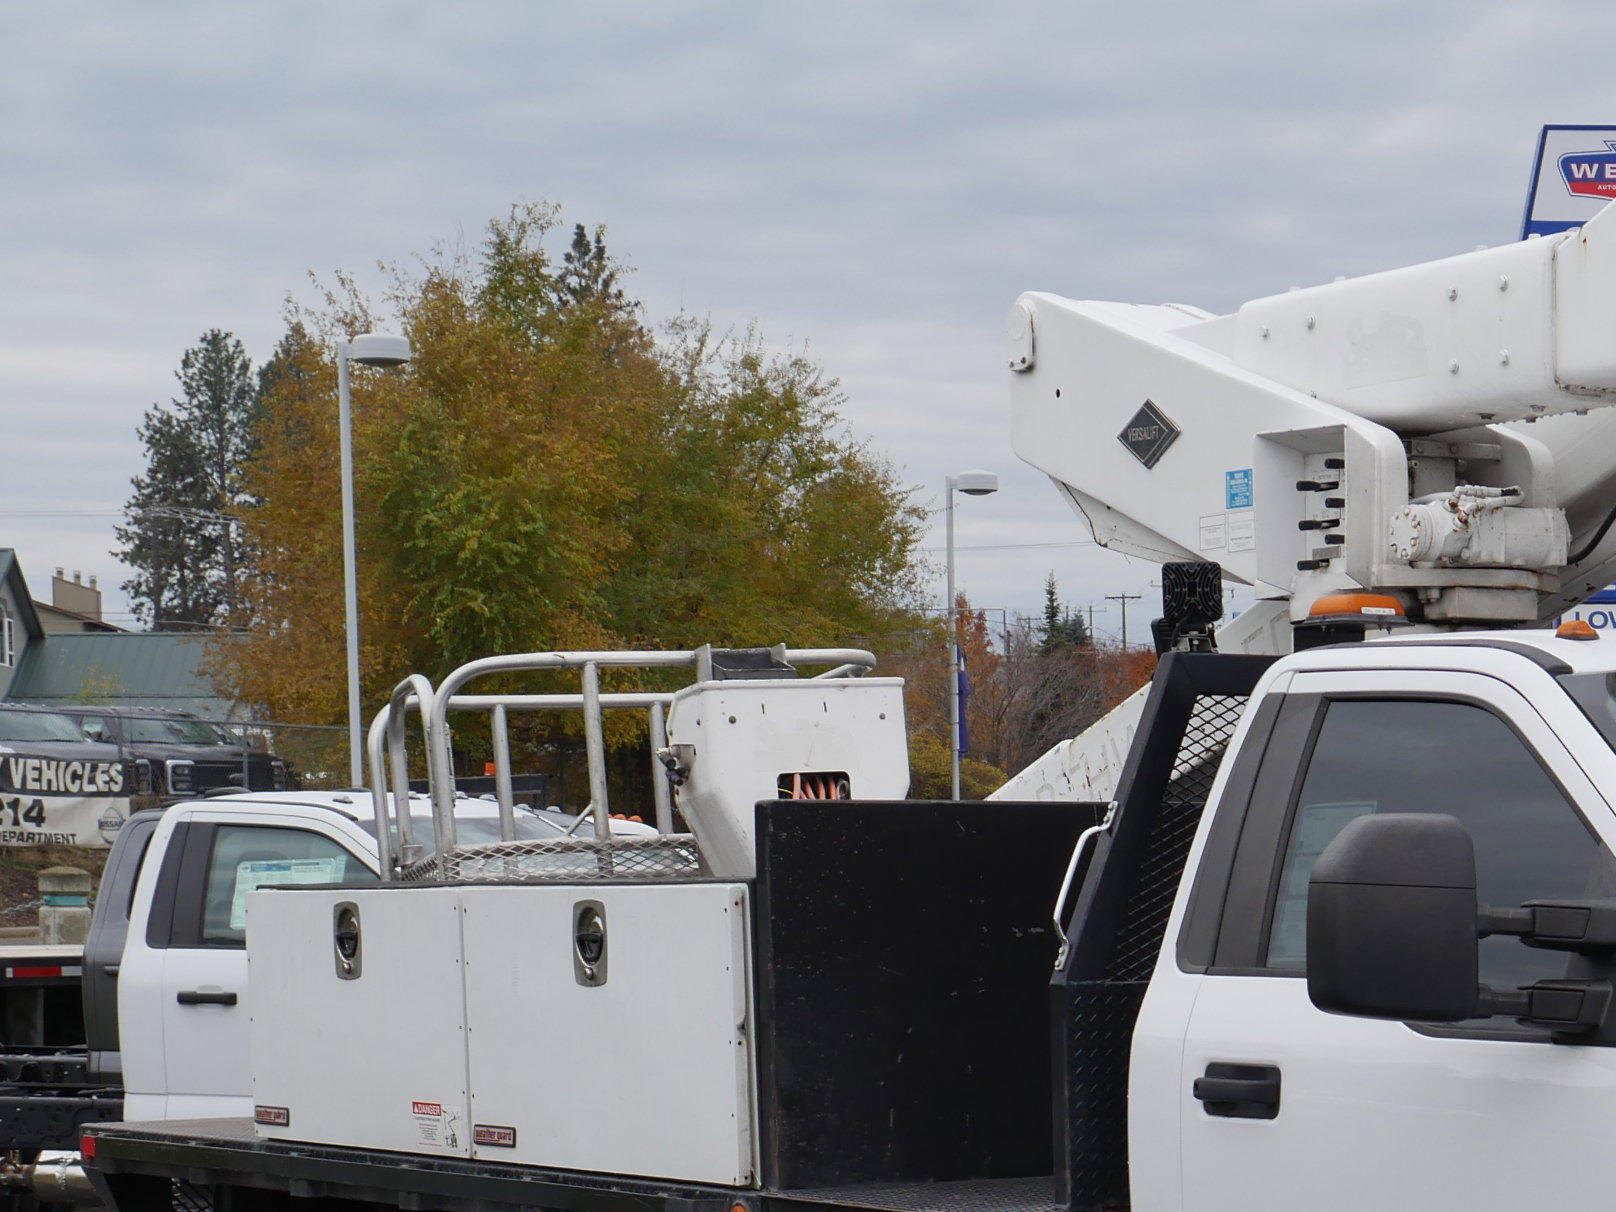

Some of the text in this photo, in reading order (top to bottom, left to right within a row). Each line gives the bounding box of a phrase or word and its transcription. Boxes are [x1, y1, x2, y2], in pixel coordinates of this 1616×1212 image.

[1128, 425, 1159, 442] VERSALIFT
[9, 757, 124, 793] VEHICLES
[0, 797, 46, 828] 14
[0, 830, 77, 845] EPARTMENT
[418, 1104, 441, 1115] DANGER
